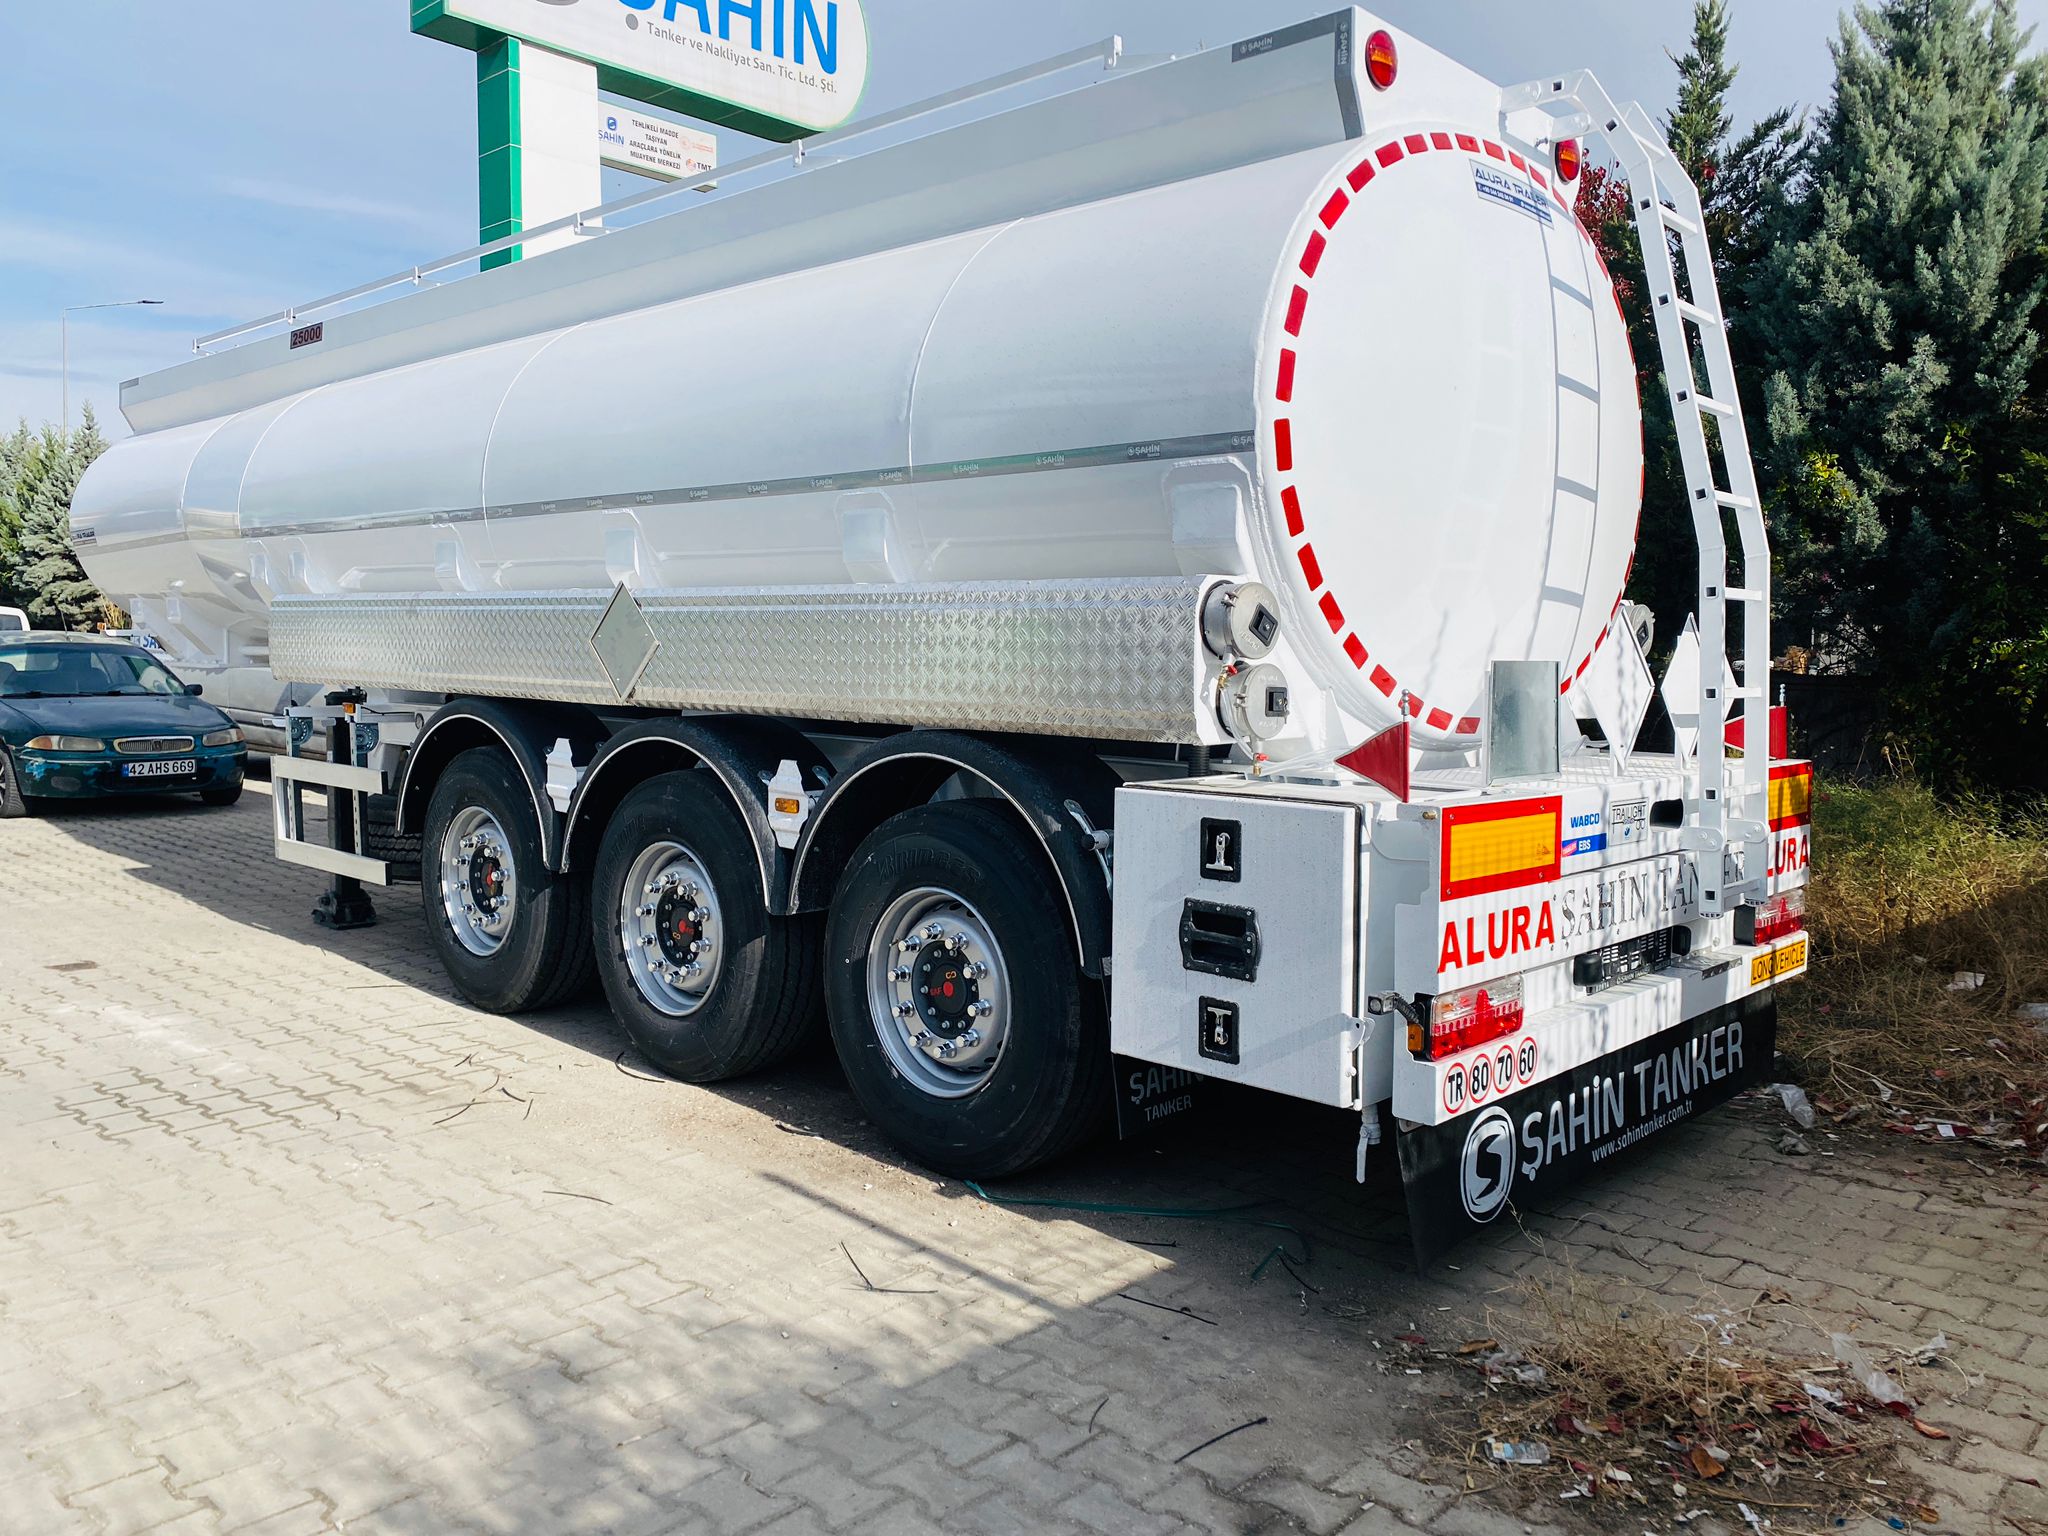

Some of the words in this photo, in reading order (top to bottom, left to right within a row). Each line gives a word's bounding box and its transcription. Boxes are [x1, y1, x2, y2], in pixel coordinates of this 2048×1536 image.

[647, 21, 687, 46] Tanker
[689, 39, 703, 52] ve
[705, 41, 750, 67] Nakliyat
[753, 57, 776, 75] San.
[778, 65, 796, 81] Tic.
[799, 71, 818, 88] Ltd.
[820, 77, 837, 94] Şti.
[660, 127, 679, 139] MADDE
[1476, 168, 1511, 191] ALURA
[291, 325, 322, 346] 25000
[129, 763, 145, 775] 42
[147, 762, 170, 775] AHS
[172, 760, 194, 773] 669
[1570, 812, 1600, 829] WABCO
[1578, 839, 1592, 852] EBS
[1767, 834, 1810, 878] URA
[1437, 900, 1556, 975] ALURA
[1752, 954, 1774, 981] LONG
[1775, 945, 1805, 972] VEHICLE
[1498, 1053, 1513, 1085] 70
[1520, 1045, 1535, 1076] 60
[1633, 1021, 1744, 1117] TANKER
[1448, 1071, 1463, 1104] TR
[1472, 1062, 1489, 1095] 80
[1144, 1095, 1192, 1122] TANKER
[1591, 1099, 1694, 1163] www.sahintanker.com.tr
